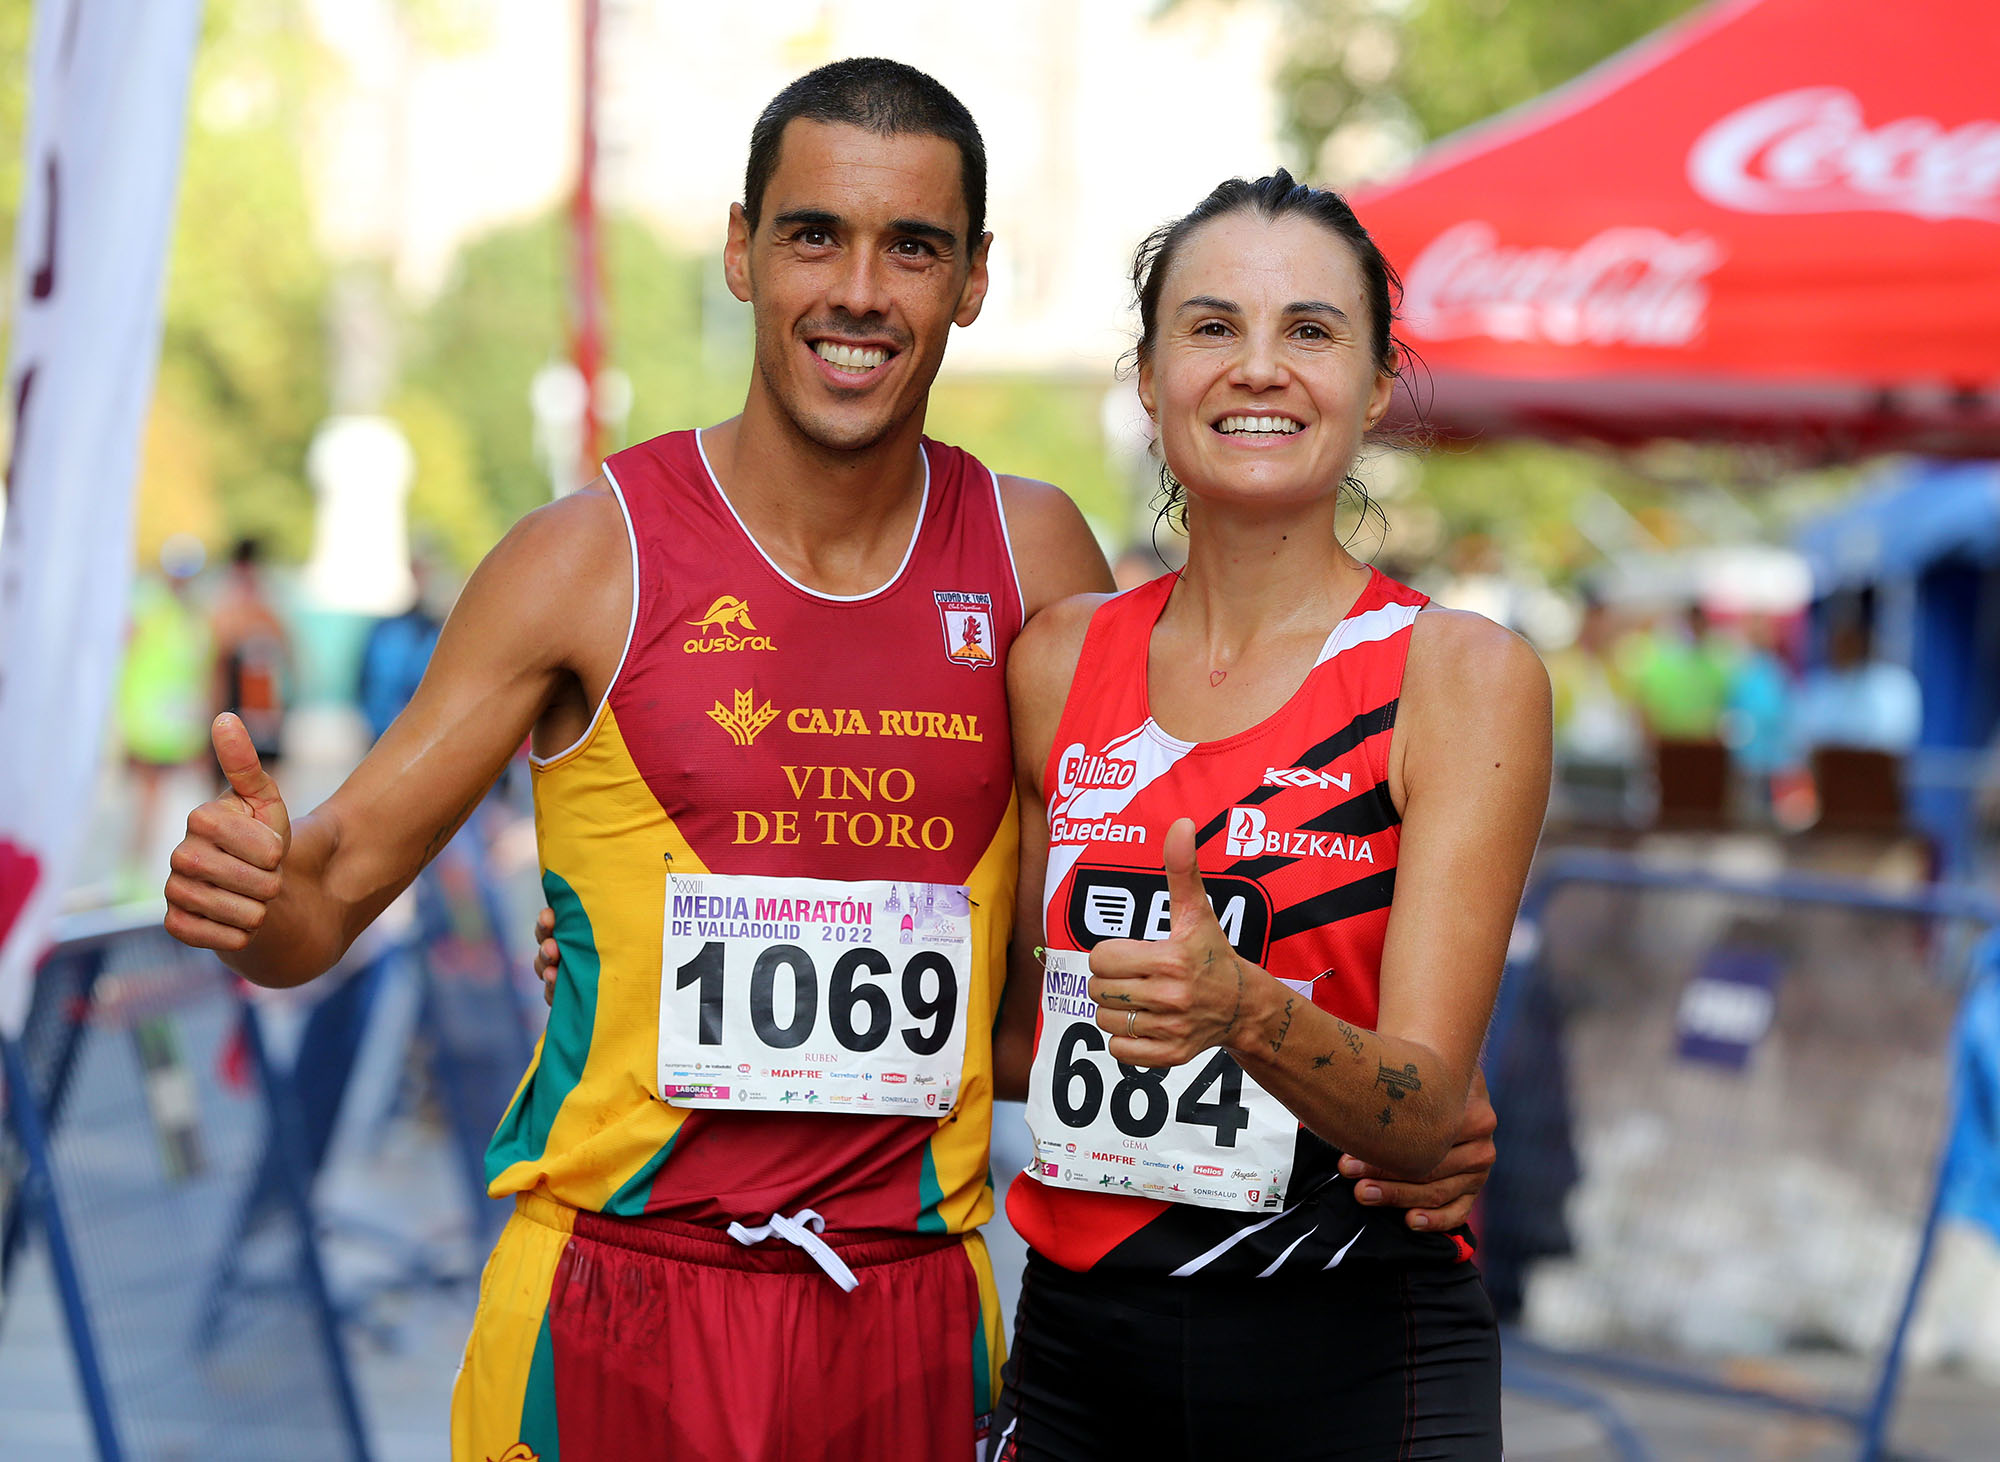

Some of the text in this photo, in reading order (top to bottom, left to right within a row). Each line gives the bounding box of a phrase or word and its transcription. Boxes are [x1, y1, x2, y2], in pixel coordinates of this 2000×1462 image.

[936, 593, 989, 604] CIUDAD DE TORO
[683, 636, 778, 654] austral
[787, 708, 983, 742] CAJA RURAL
[1062, 751, 1135, 787] Bilbao
[780, 765, 916, 802] VINO
[731, 811, 954, 851] DE TORO
[1052, 818, 1147, 844] Guedan
[1265, 831, 1374, 864] BIZKAIA
[674, 880, 703, 894] XXXIII
[673, 895, 872, 925] MEDIA MARATÓN
[672, 920, 872, 943] DE VALLADOLID 2022
[1047, 971, 1087, 999] MEDIA
[676, 942, 957, 1055] 1069
[1059, 997, 1096, 1018] VALLAD
[805, 1053, 838, 1063] RUBEN
[771, 1069, 823, 1079] MAPFRE
[882, 1074, 906, 1082] Helios
[675, 1086, 709, 1094] LABORAL
[1052, 1022, 1250, 1148] 684
[881, 1096, 919, 1104] SONRISALUD
[1122, 1139, 1148, 1151] GEMA
[1092, 1151, 1136, 1166] MAPFRE
[1143, 1160, 1170, 1169] Carrefour
[1195, 1166, 1222, 1176] Helios
[1193, 1188, 1237, 1199] SONRISALUD
